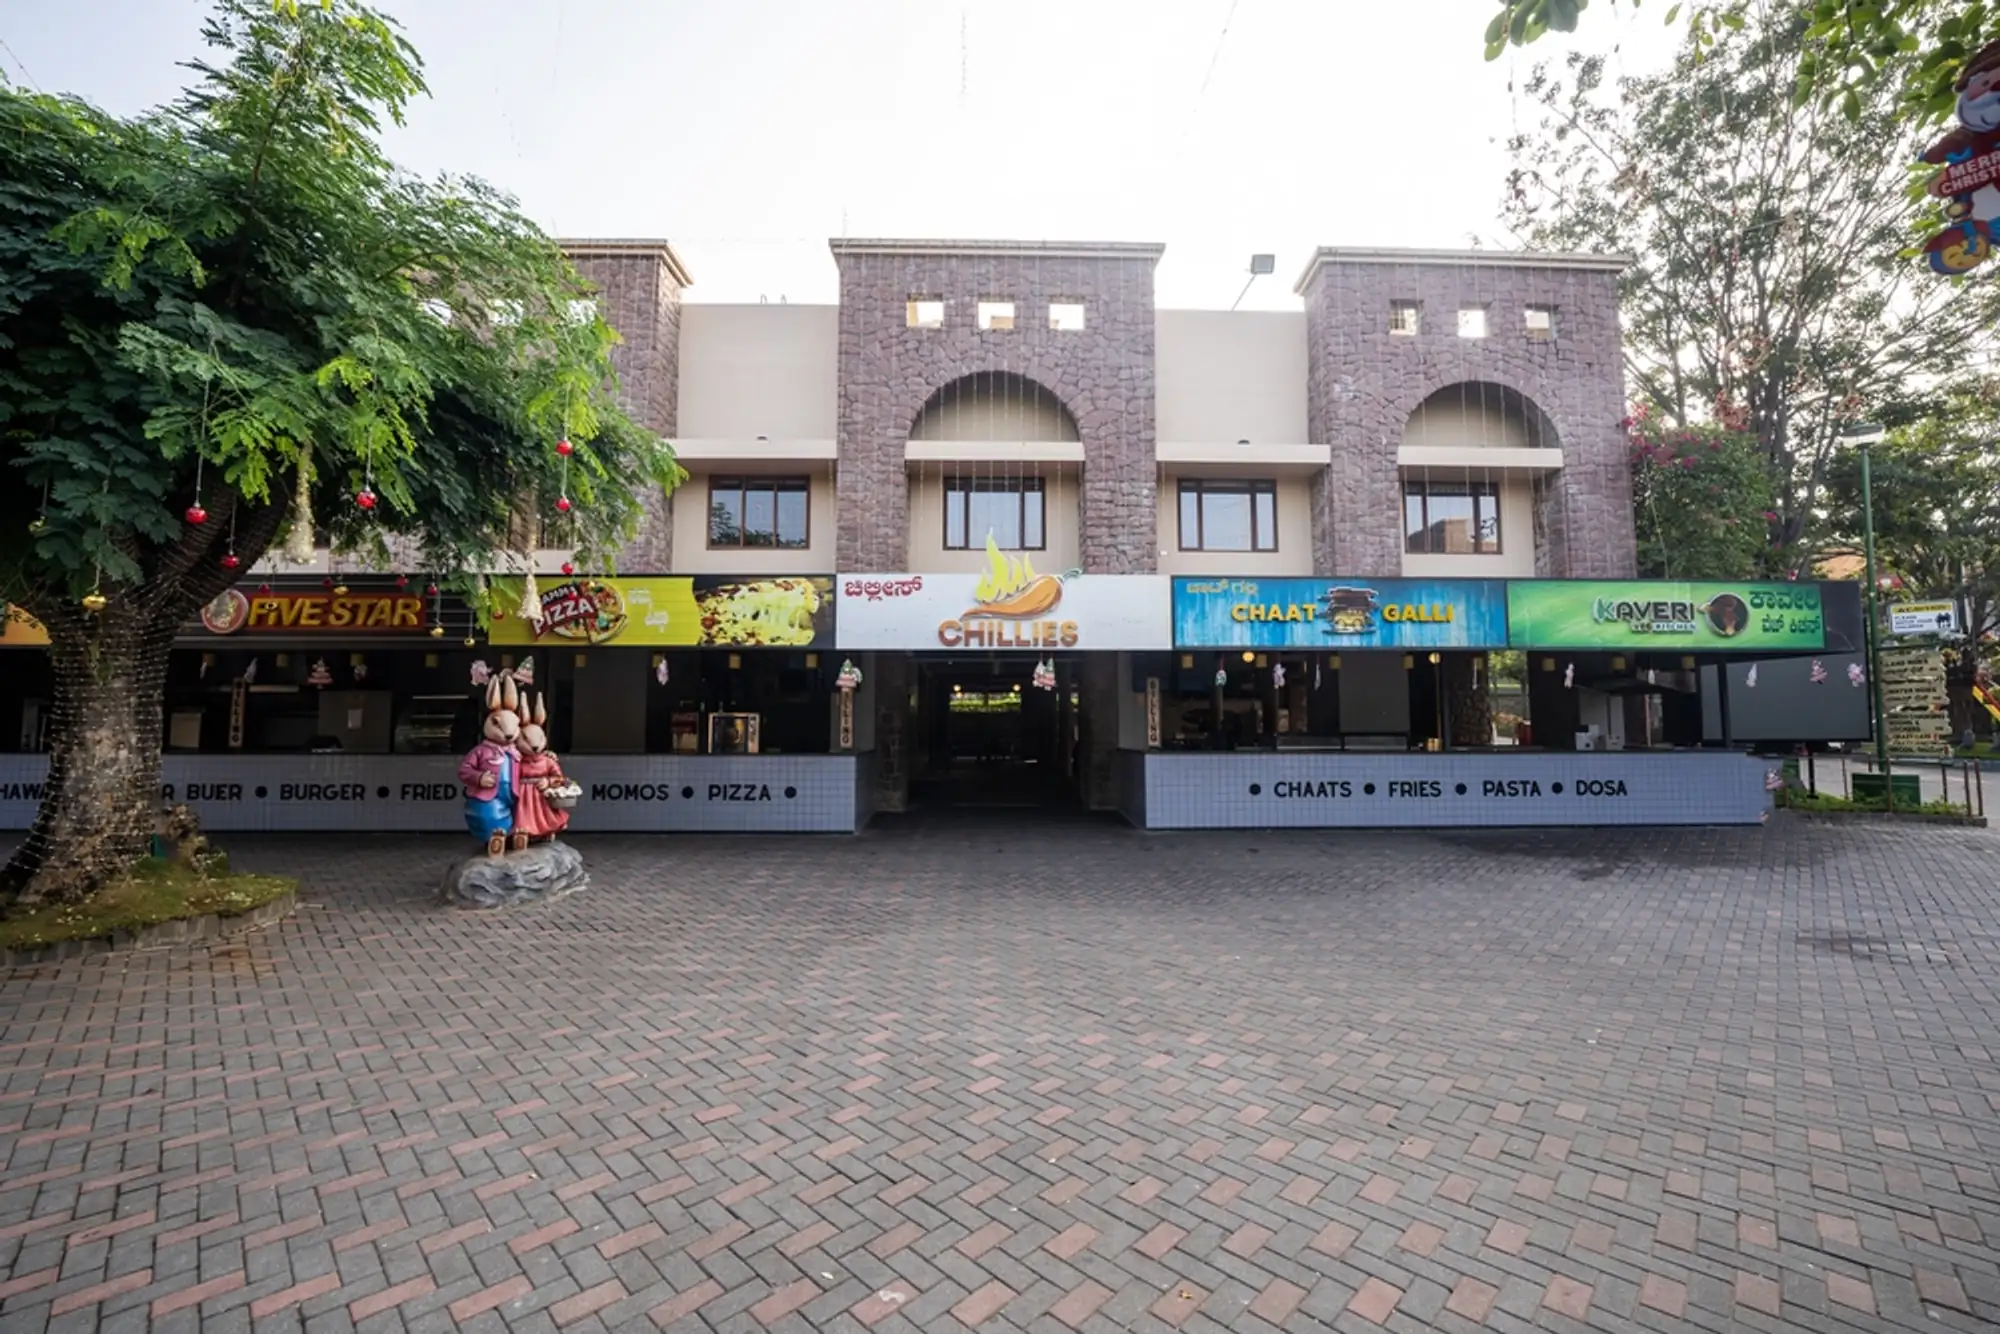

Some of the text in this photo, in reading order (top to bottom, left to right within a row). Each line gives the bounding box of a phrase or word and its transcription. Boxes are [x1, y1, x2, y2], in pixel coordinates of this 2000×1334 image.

[1941, 164, 2000, 194] CHRIST
[248, 598, 329, 626] FIVE
[328, 598, 422, 626] STAR
[532, 598, 595, 635] PIZZA
[1231, 604, 1454, 622] CHAAT GALLI
[1593, 600, 1695, 622] KAVERI
[938, 620, 1079, 647] CHILLIES
[1149, 680, 1157, 743] BILLING
[186, 783, 243, 800] BUER
[280, 783, 366, 801] BURGER
[401, 783, 457, 801] FRIED
[591, 783, 669, 801] MOMOS
[708, 783, 771, 801] PIZZA
[1273, 779, 1628, 798] CHAATS FRIES PASTA DOSA
